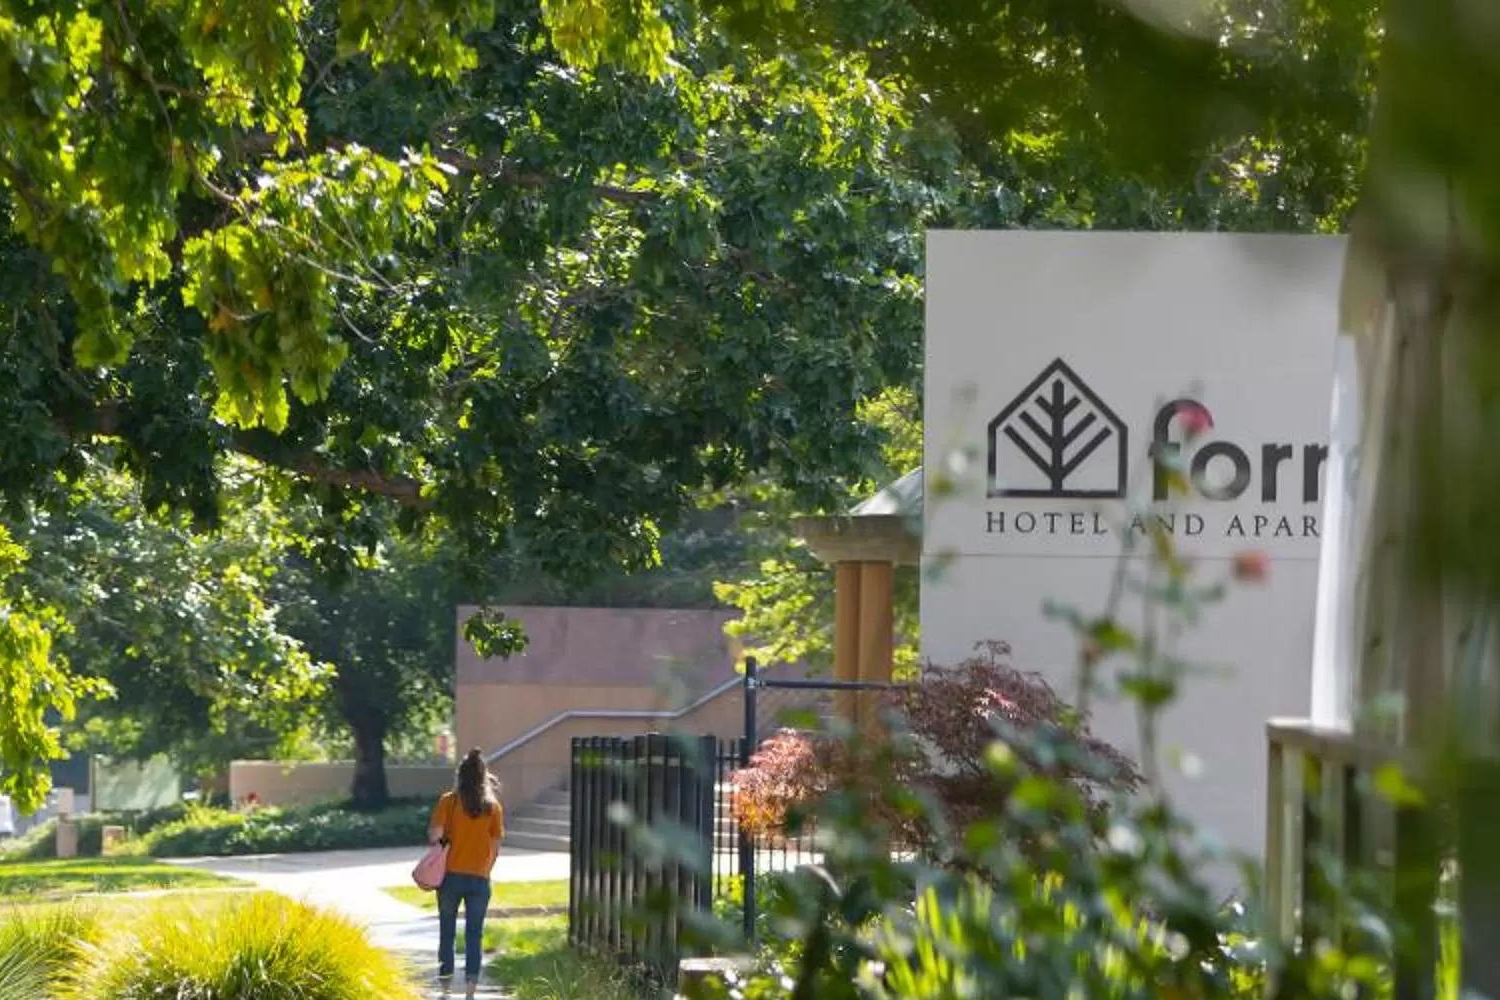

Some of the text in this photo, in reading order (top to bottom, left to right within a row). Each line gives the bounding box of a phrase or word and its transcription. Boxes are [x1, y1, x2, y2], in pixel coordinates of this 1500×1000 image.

[987, 511, 1320, 537] HOTEL AND APAR
